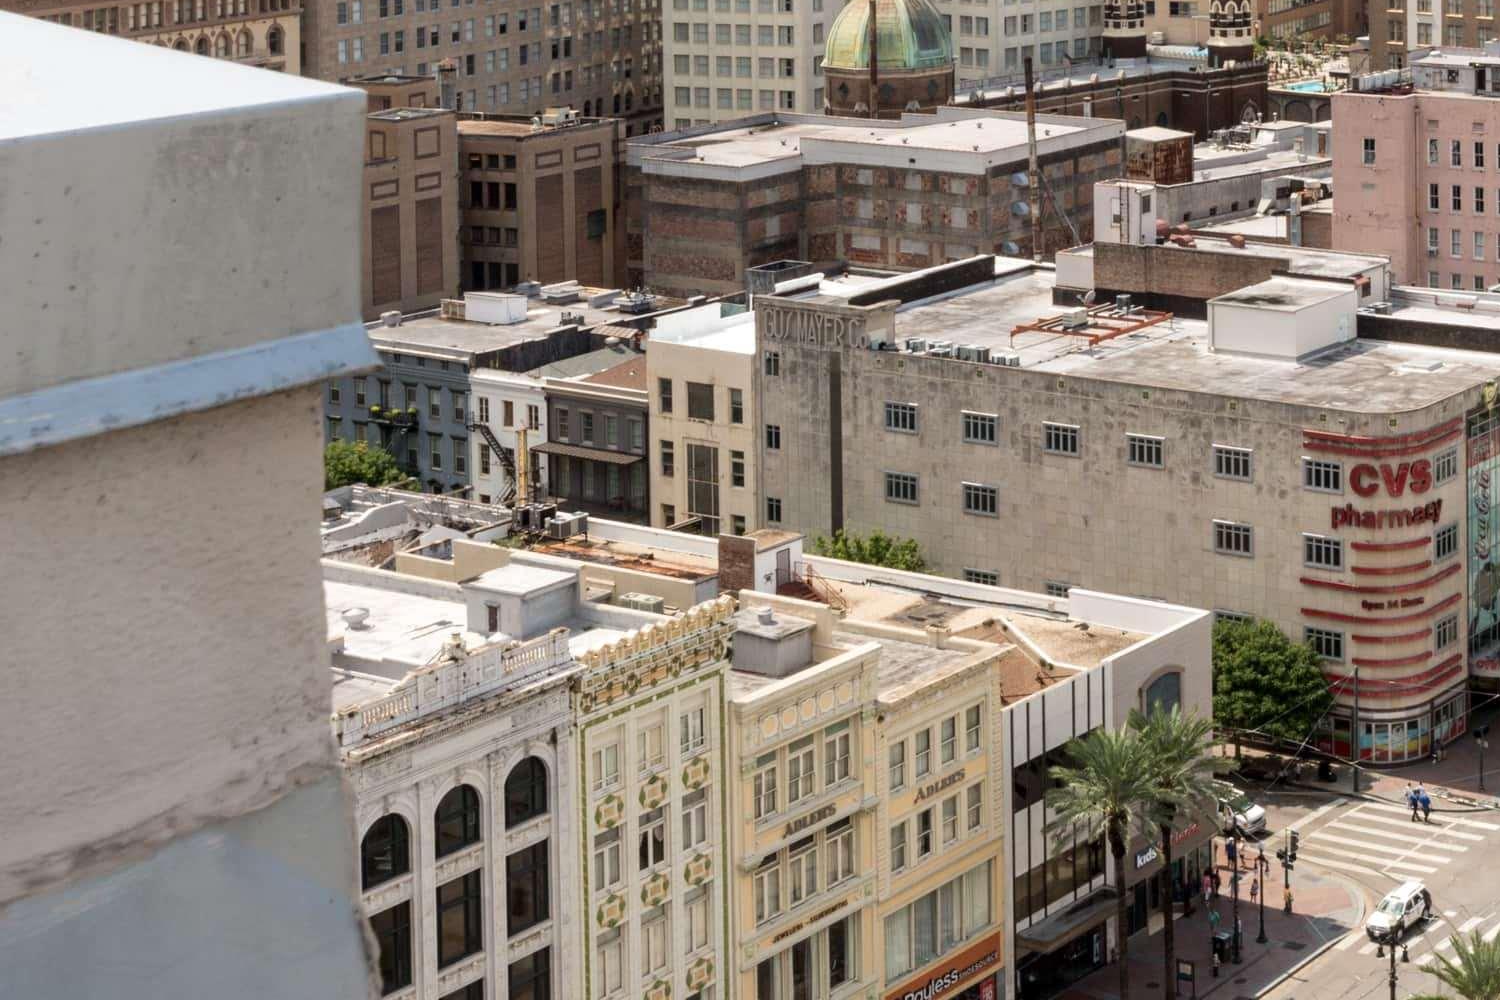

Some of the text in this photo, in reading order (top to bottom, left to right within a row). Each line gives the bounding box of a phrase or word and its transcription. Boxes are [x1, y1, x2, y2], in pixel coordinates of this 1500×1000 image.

[764, 308, 793, 340] GUS
[796, 311, 845, 346] MAYER
[1349, 459, 1432, 497] CVS
[1331, 499, 1442, 529] pharmacy
[1136, 847, 1157, 869] kids
[904, 969, 959, 1000] Payless
